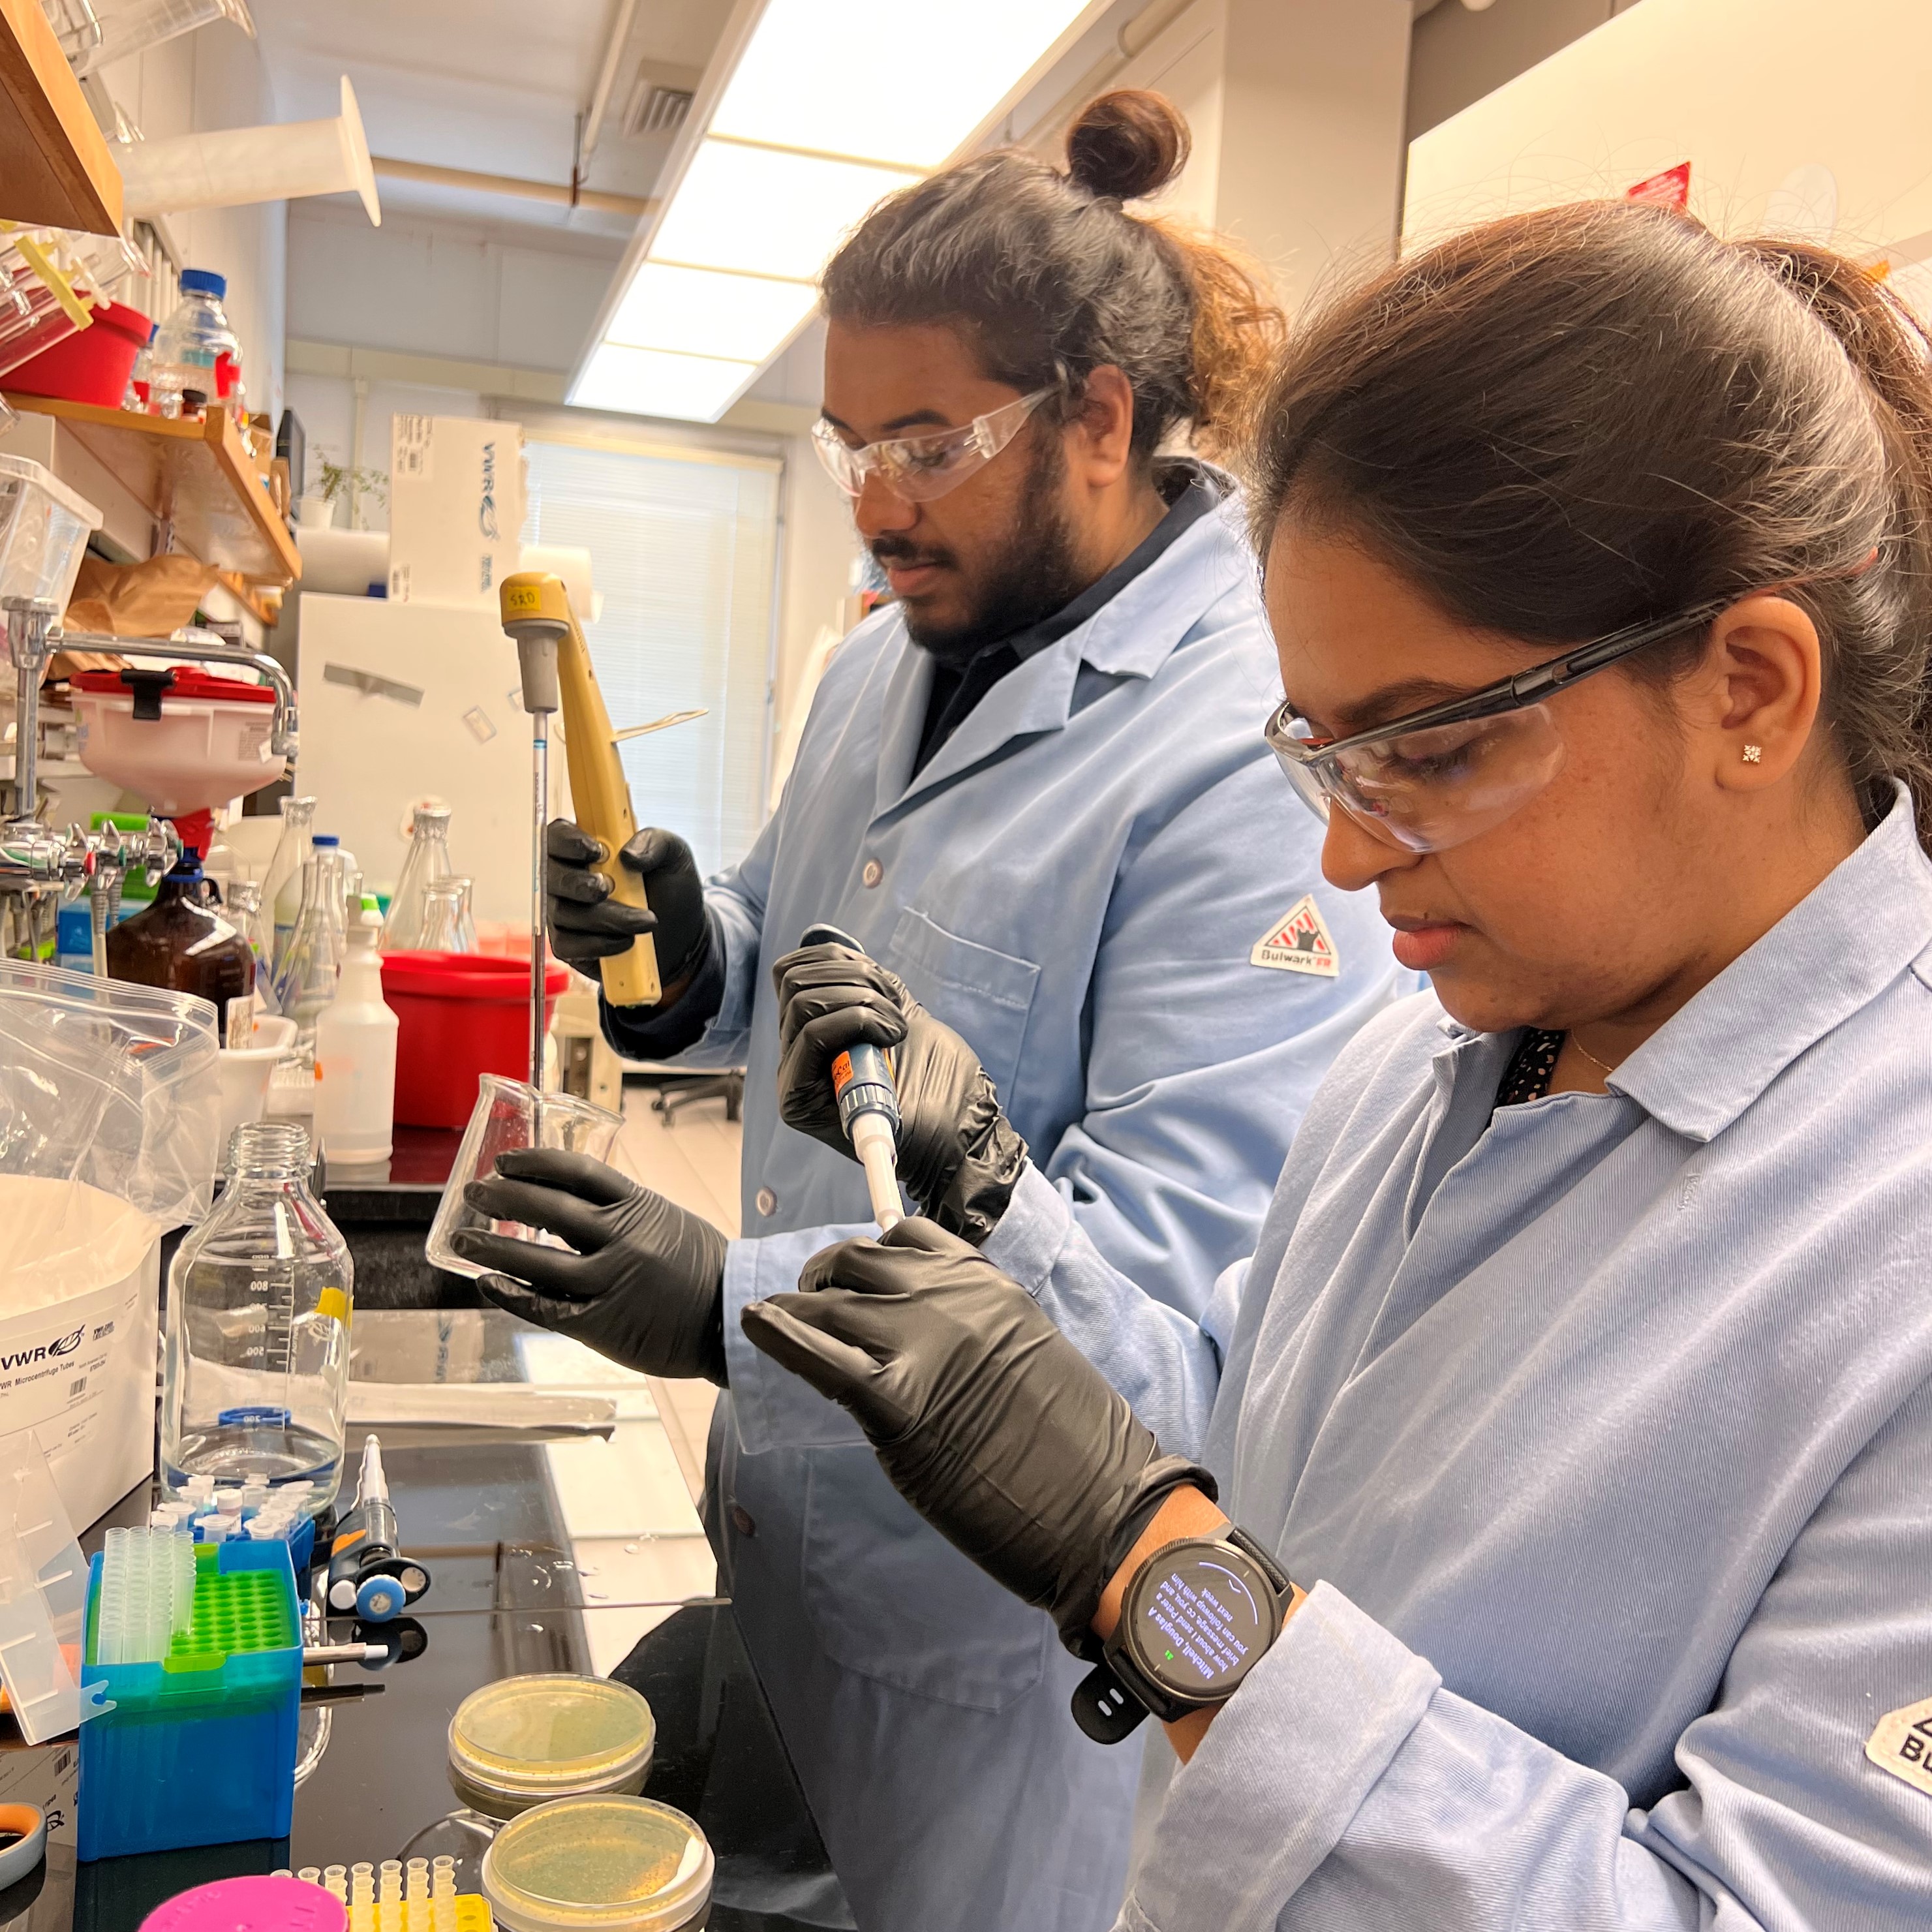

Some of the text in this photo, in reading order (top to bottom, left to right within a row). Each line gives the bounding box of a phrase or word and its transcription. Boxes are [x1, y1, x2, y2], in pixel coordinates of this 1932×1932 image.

[482, 442, 495, 493] VWR
[1261, 949, 1312, 966] Bulwark
[1, 1346, 46, 1371] VWR
[15, 1366, 59, 1386] Microcentrifuge
[60, 1360, 75, 1372] Tubes
[1160, 1581, 1175, 1595] and
[1161, 1599, 1178, 1619] Peter
[1172, 1573, 1248, 1655] you can followup with him
[1187, 1608, 1196, 1618] cc
[1201, 1588, 1233, 1622] next week
[1176, 1616, 1193, 1634] send
[1148, 1607, 1214, 1679] Mitchell, Douglas A
[1195, 1635, 1214, 1656] about
[1213, 1655, 1228, 1672] how
[1221, 1647, 1239, 1666] brief
